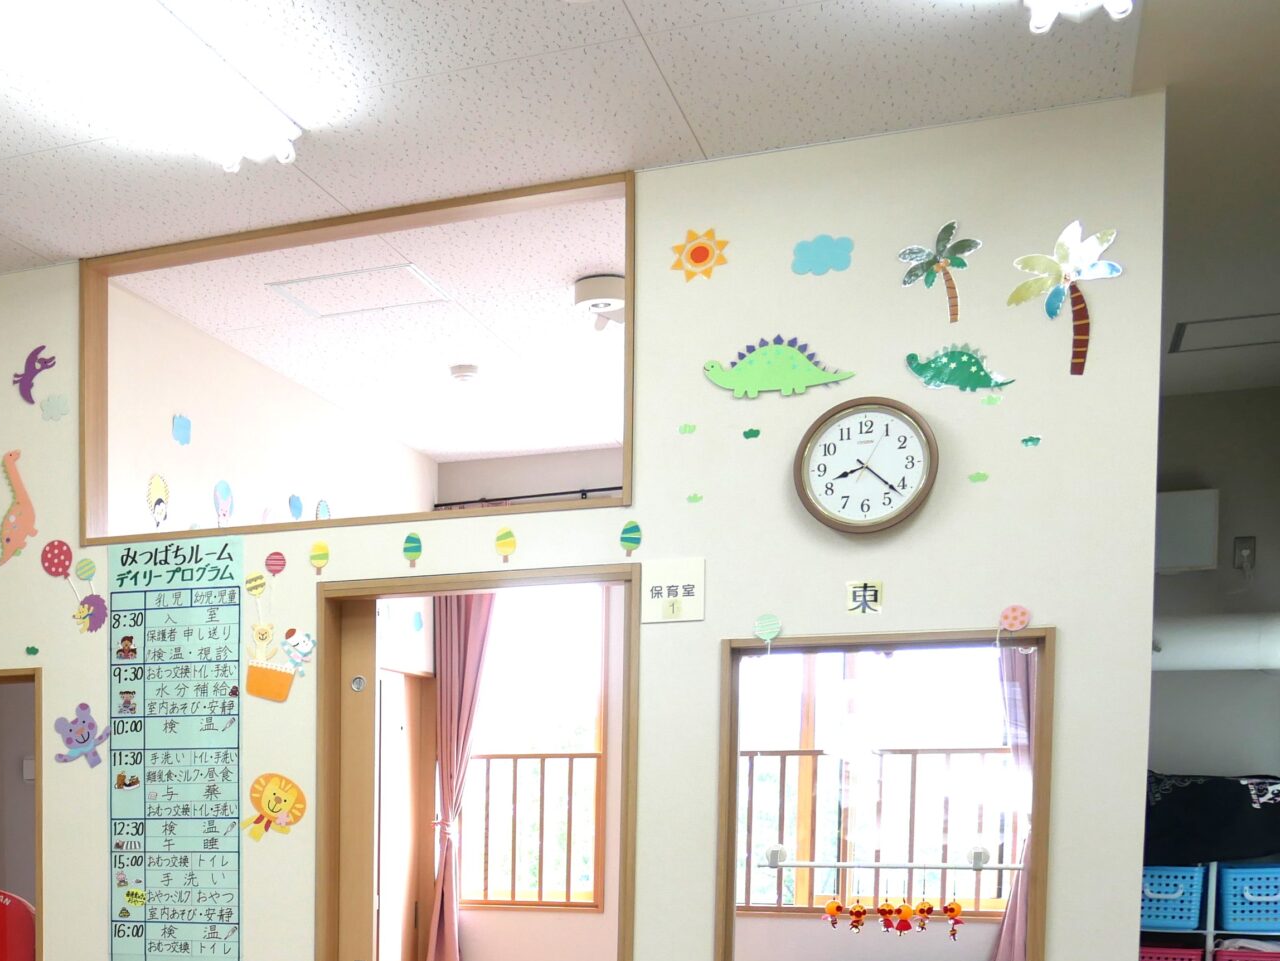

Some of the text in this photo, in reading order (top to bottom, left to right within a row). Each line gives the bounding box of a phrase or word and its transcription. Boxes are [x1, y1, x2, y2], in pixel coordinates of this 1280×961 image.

[839, 427, 852, 441] 11
[859, 420, 874, 434] 12
[884, 424, 890, 436] 1
[897, 435, 907, 449] 2
[822, 443, 836, 456] 10
[904, 456, 915, 469] 3
[817, 464, 826, 477] 9
[825, 482, 834, 496] 8
[897, 476, 907, 490] 4
[841, 496, 850, 510] 7
[860, 499, 870, 512] 6
[882, 492, 892, 506] 5
[120, 543, 234, 566] みつばちルーム
[116, 564, 235, 587] デイリープログラム
[193, 590, 237, 605] 幼児・児童
[650, 584, 696, 599] 保育室
[847, 582, 879, 613] 東
[155, 592, 184, 607] 乳児
[669, 602, 675, 615] 1
[112, 611, 144, 629] 8:30
[113, 667, 144, 683] 9:30
[146, 666, 190, 680] おむつ交換
[155, 683, 230, 698] 水分補給
[112, 719, 143, 735] 10:00
[164, 717, 219, 734] 検温
[113, 751, 142, 767] 11:30
[150, 752, 185, 765] 手洗い
[148, 804, 190, 817] おむつ交換
[113, 821, 144, 836] 12:30
[162, 820, 220, 836] 検温
[113, 854, 143, 868] 15:00
[148, 856, 189, 868] おむつ交換
[198, 855, 229, 868] トイレ
[160, 872, 226, 887] 手洗い
[197, 891, 234, 903] おやつ
[114, 924, 144, 938] 16:00
[161, 925, 221, 939] 検温
[148, 942, 190, 953] おむつ交換
[199, 943, 231, 955] トイレ
